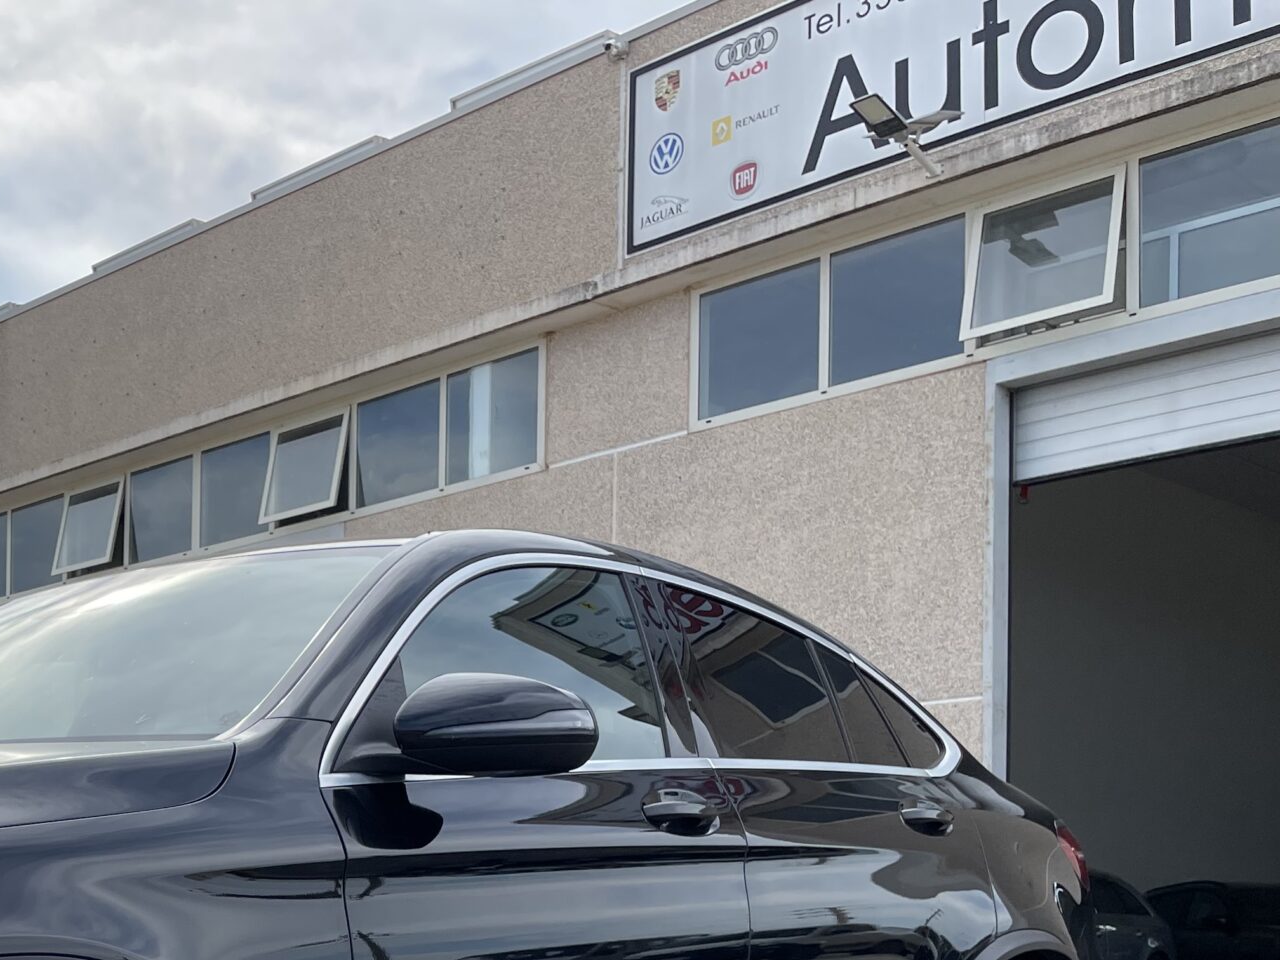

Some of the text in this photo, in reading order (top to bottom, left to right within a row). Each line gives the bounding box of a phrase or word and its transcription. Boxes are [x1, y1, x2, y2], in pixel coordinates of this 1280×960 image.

[724, 60, 769, 87] Audi
[735, 104, 781, 130] RENAULT
[735, 167, 756, 190] FIAT
[640, 203, 683, 230] JAGUAR
